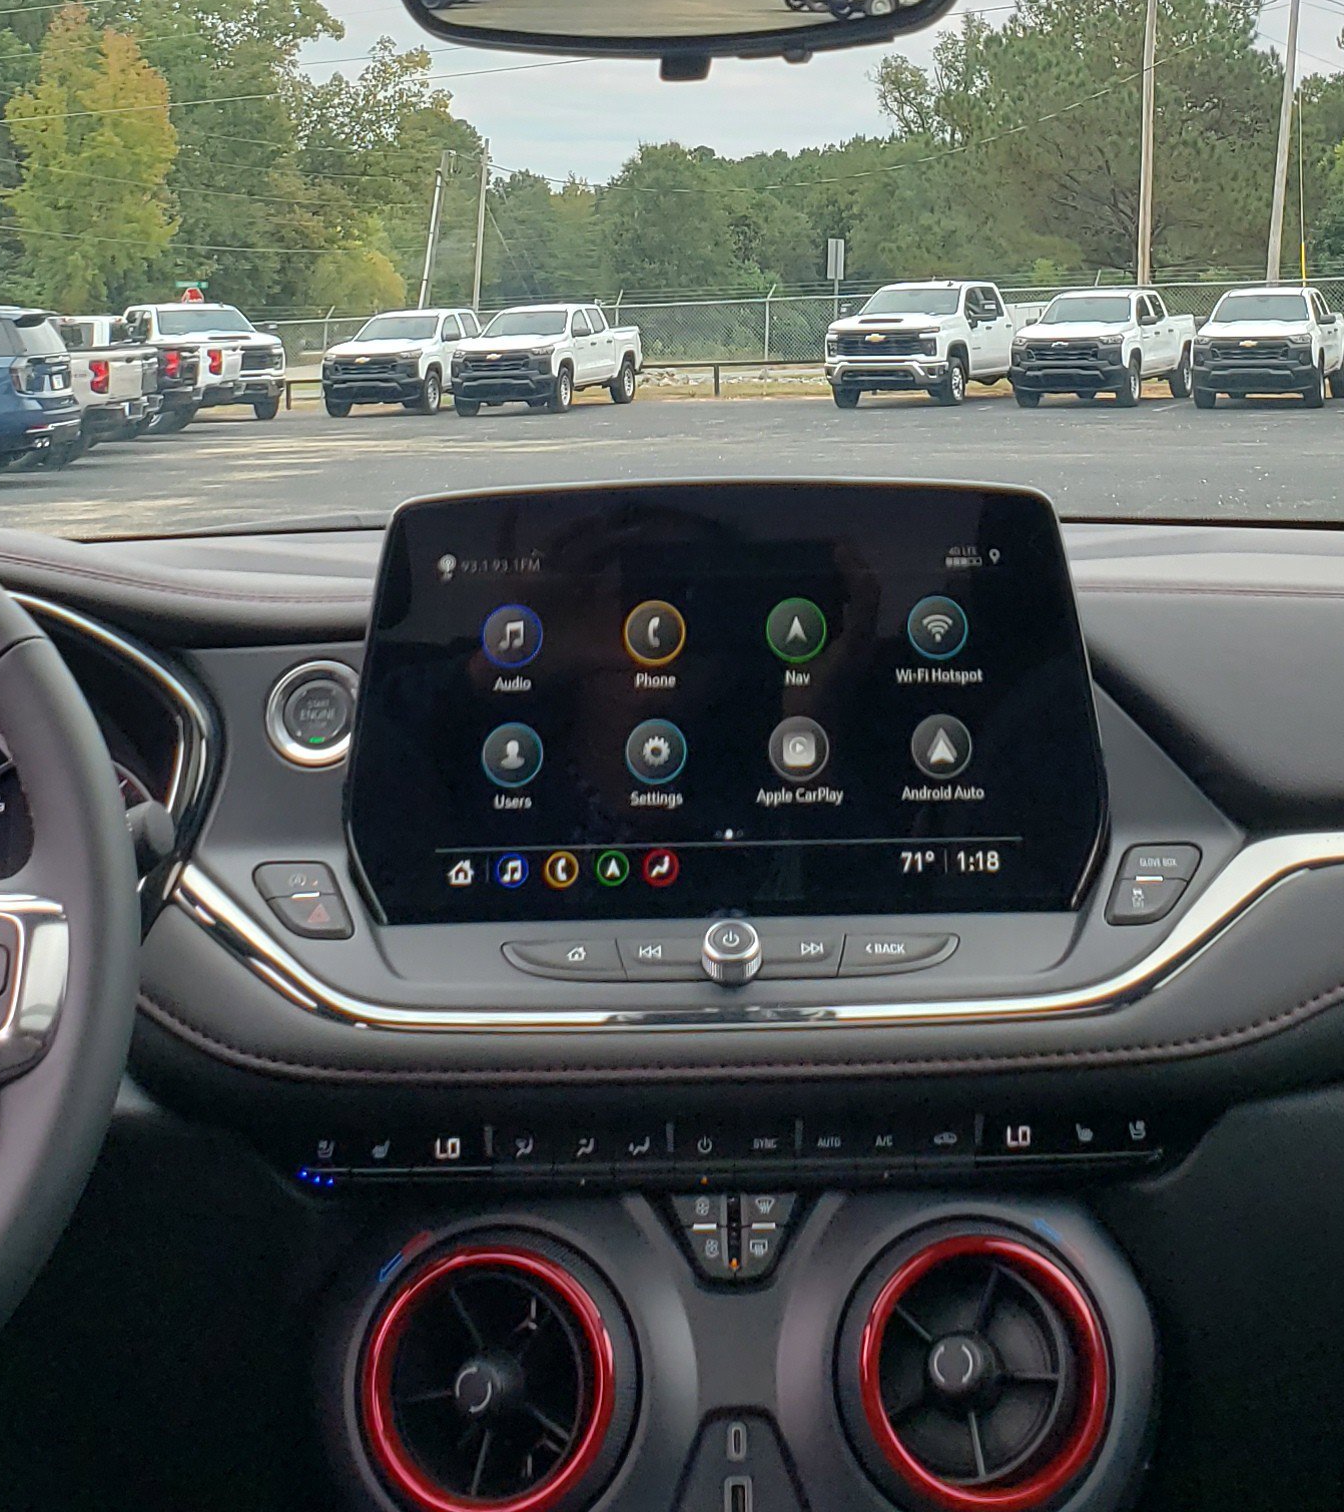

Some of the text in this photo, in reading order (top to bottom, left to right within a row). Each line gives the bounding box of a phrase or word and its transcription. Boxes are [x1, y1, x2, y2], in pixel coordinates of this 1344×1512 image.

[493, 676, 532, 691] Audio
[634, 672, 676, 688] Phone
[785, 670, 810, 686] Nav
[896, 668, 983, 685] Wi-Fi Hotspot
[630, 791, 683, 809] Settings
[756, 787, 843, 806] Apple CarPlay
[902, 785, 984, 801] Android Auto
[494, 794, 532, 809] Users
[957, 850, 999, 872] 1:18
[1162, 858, 1177, 866] BOX
[874, 943, 905, 954] BACK
[817, 1136, 841, 1147] AUTO
[875, 1135, 893, 1147] A/C
